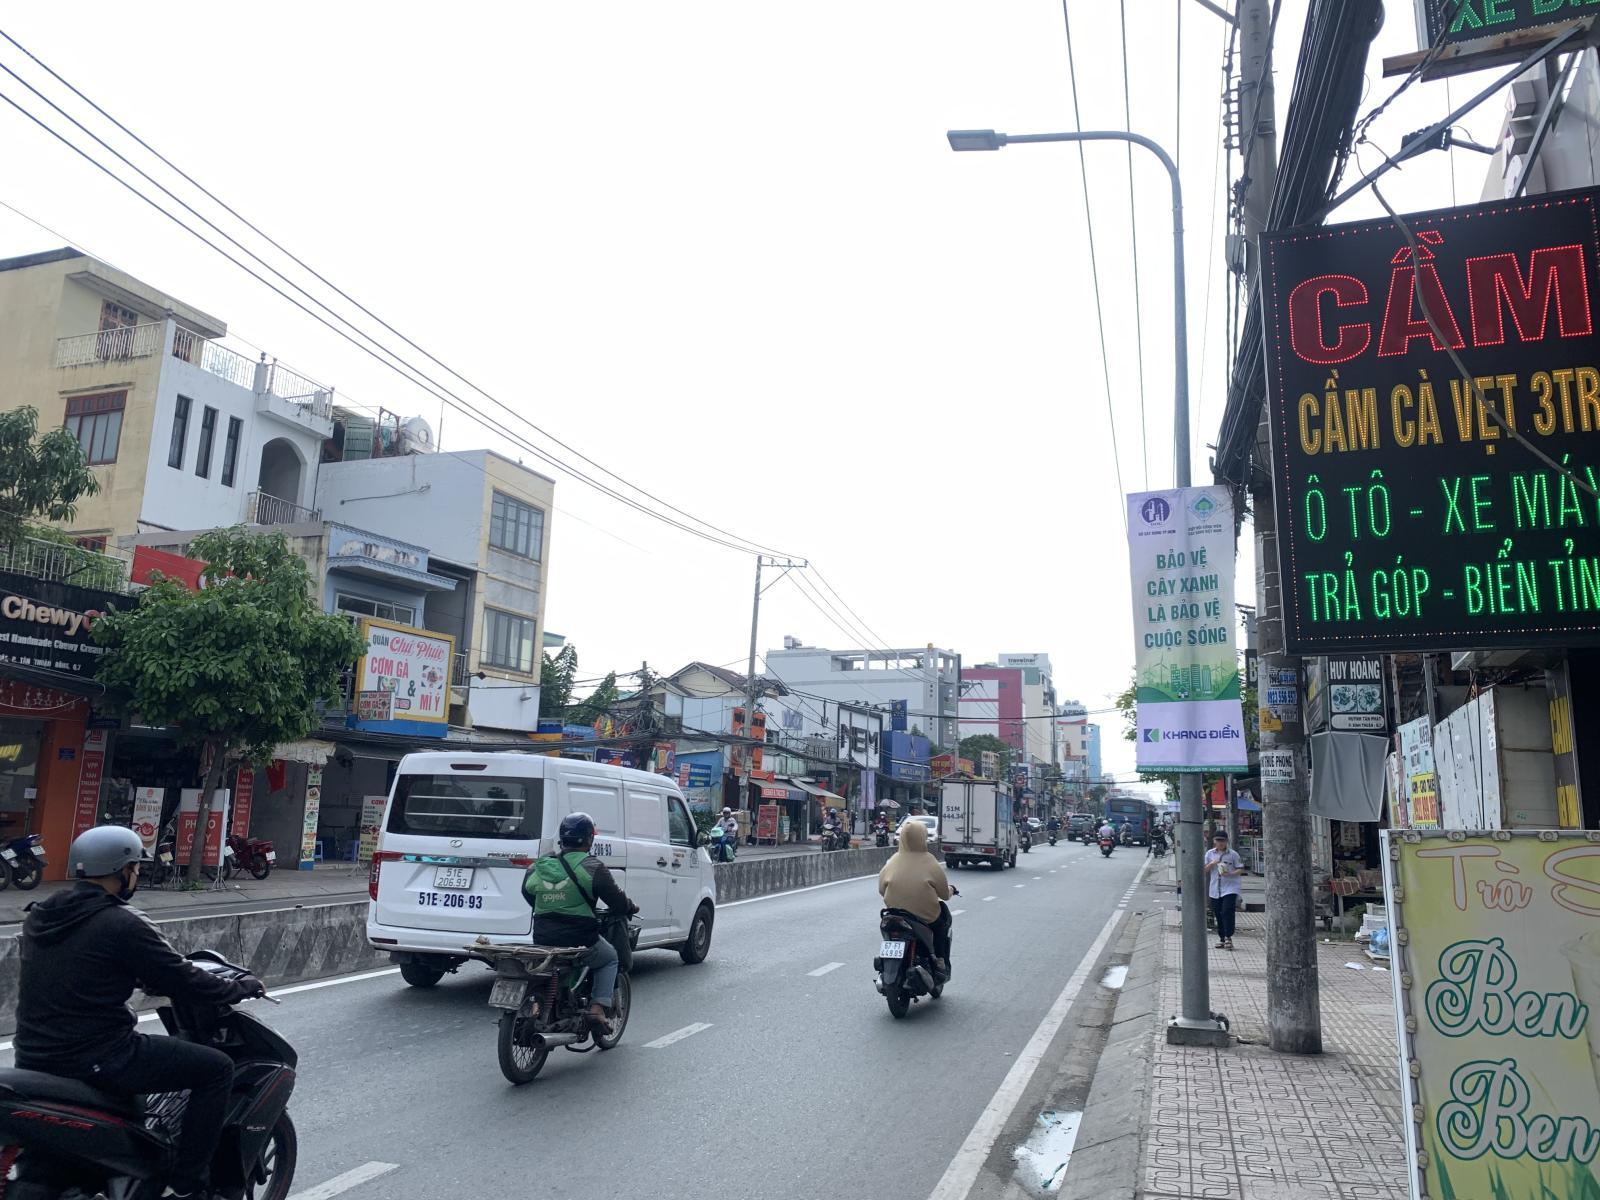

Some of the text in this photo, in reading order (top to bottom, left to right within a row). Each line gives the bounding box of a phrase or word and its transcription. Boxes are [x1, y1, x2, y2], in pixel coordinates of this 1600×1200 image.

[1289, 230, 1593, 364] CẦM
[1298, 369, 1381, 455] CẦM
[1391, 369, 1443, 447] CÀ
[1450, 374, 1517, 455] VẸT
[1305, 475, 1327, 541] Ô
[1343, 470, 1390, 538] TÔ
[1441, 476, 1494, 532] XE
[1156, 546, 1207, 569] BẢO VỆ
[1147, 574, 1218, 595] CÂY XANH
[1305, 551, 1361, 621] TRẢ
[1372, 555, 1430, 619] GÓP
[1465, 538, 1540, 614] BIỂN
[3, 595, 83, 637] Chewy
[1148, 598, 1220, 621] LÀ BẢO VỆ
[54, 640, 79, 652] Chewy
[372, 634, 390, 646] QUÁN
[1144, 624, 1227, 650] CUỘC SỐNG
[371, 656, 409, 678] CƠM GÀ
[1330, 656, 1381, 680] HUY HOÀNG
[407, 680, 416, 697] &
[420, 692, 432, 711] MÌ
[435, 693, 441, 712] Ý
[1163, 724, 1239, 739] KHANG ĐIỀN
[185, 819, 216, 829] PHO
[438, 877, 467, 888] 206.93
[446, 868, 463, 877] 51E
[1416, 845, 1533, 912] Trà
[542, 892, 566, 903] gojek
[1425, 937, 1589, 1040] Ben
[1437, 1058, 1600, 1164] Ben
